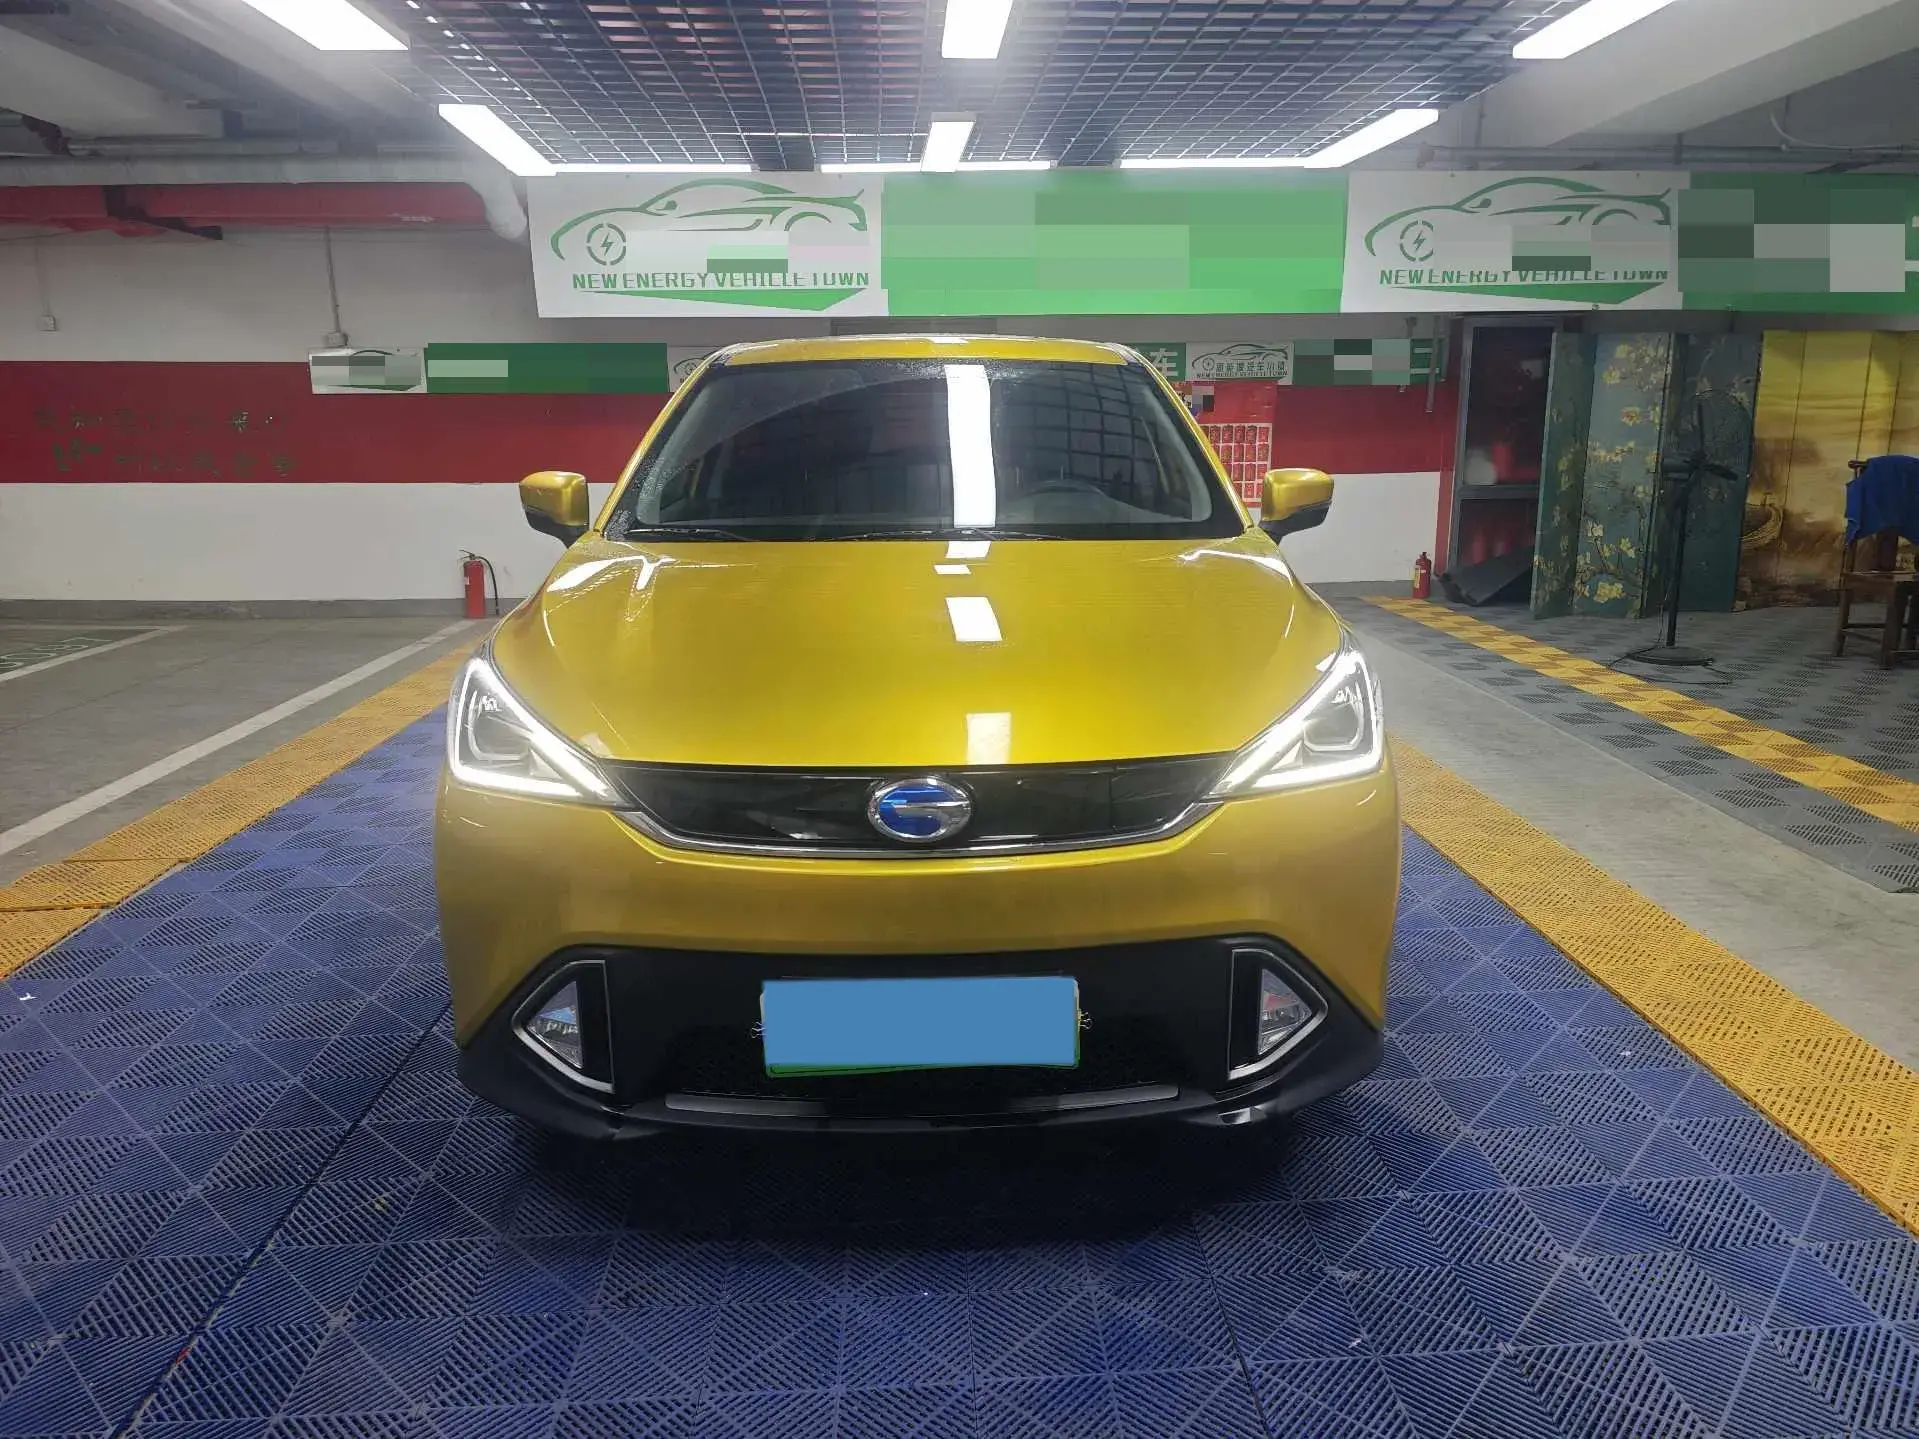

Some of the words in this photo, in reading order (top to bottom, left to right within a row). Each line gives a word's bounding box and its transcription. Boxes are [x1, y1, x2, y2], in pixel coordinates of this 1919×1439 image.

[572, 272, 617, 289] NEW
[622, 272, 709, 289] ENERGY
[1380, 269, 1423, 285] NEW
